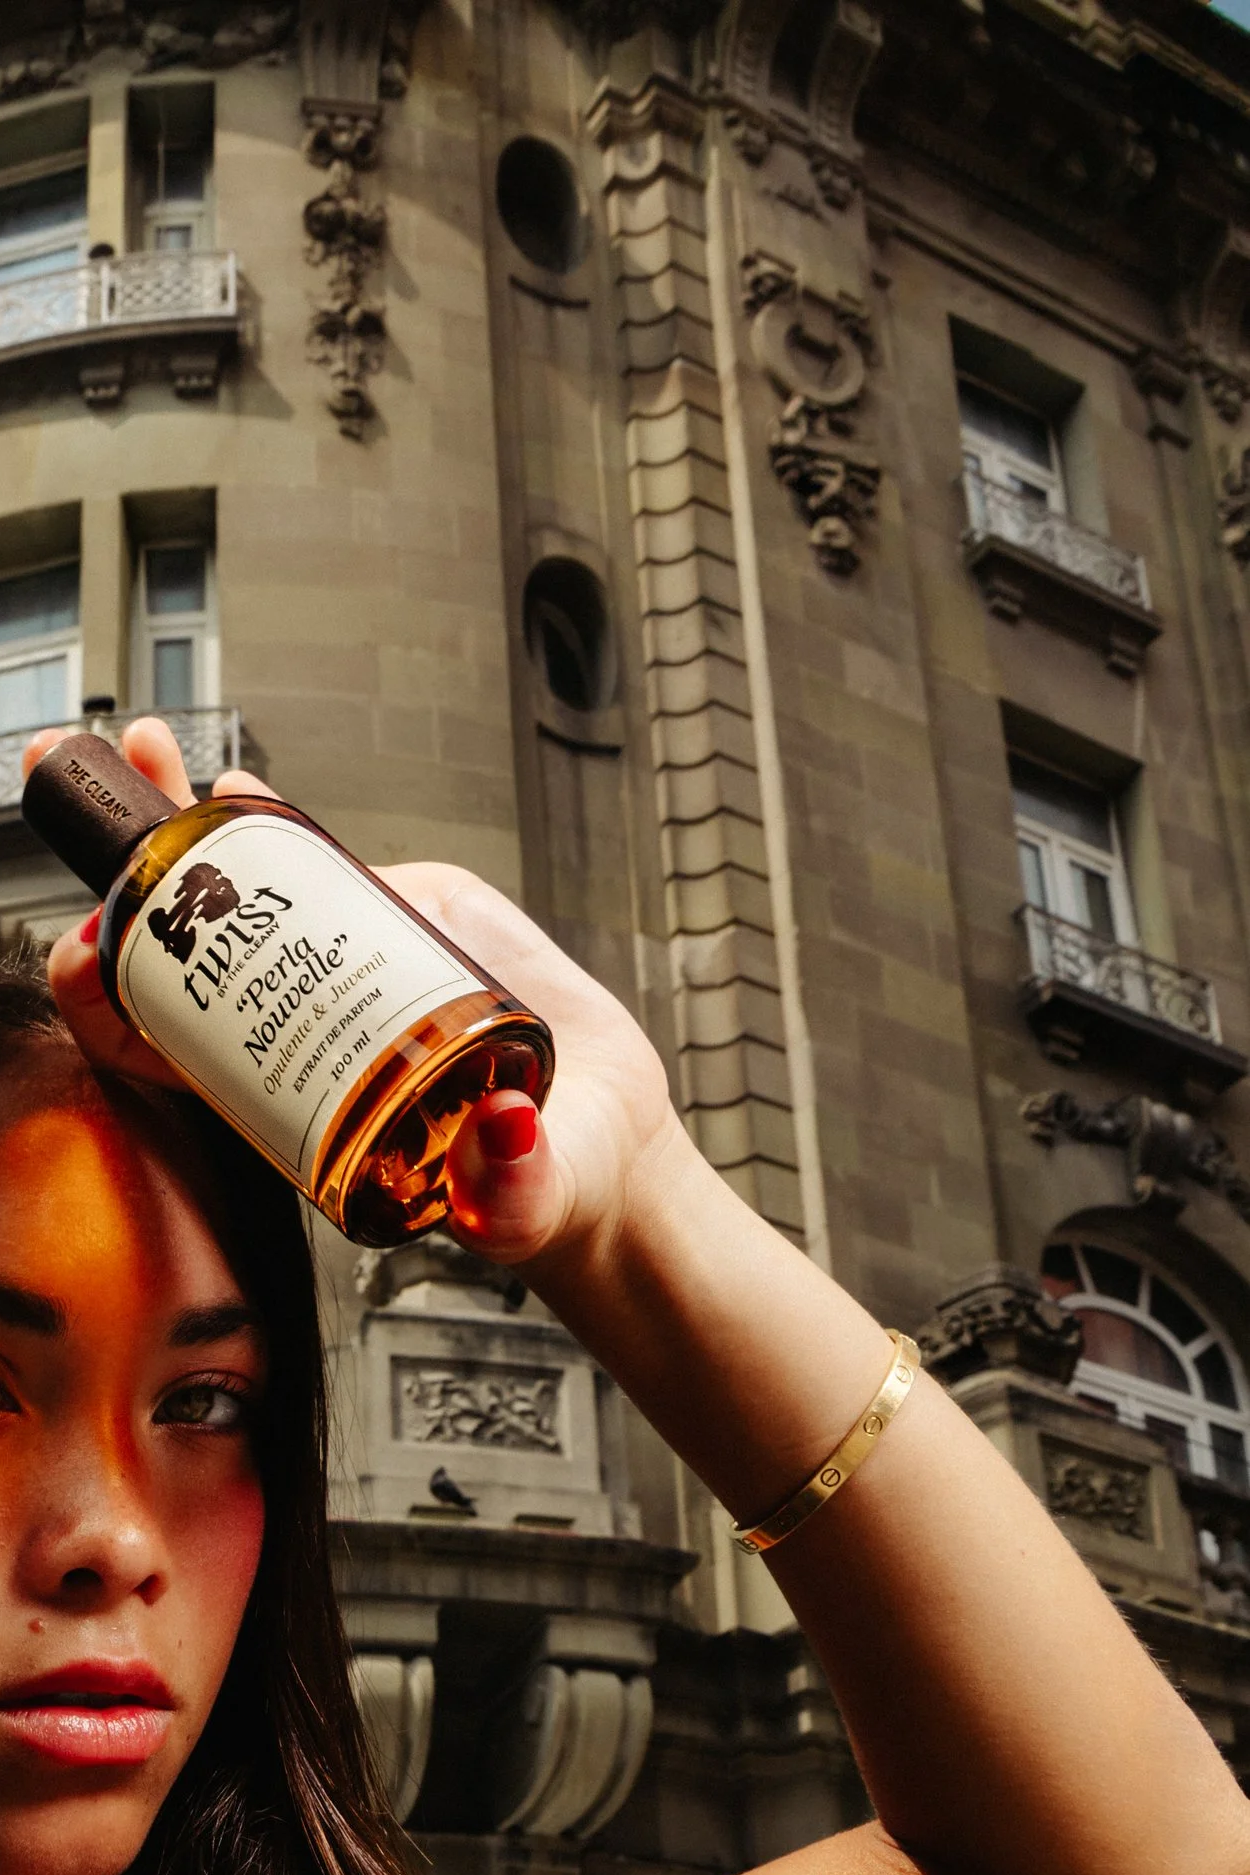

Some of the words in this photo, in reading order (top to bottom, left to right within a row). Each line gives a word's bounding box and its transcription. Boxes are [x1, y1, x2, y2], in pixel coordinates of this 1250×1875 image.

[62, 759, 91, 785] THE
[84, 780, 132, 822] CLEANY
[216, 981, 229, 998] BY
[226, 959, 246, 982] THE
[243, 921, 281, 960] CLEANY
[263, 1019, 313, 1096] Opulente
[311, 1002, 328, 1021] &
[330, 951, 388, 1004] Juvenil
[292, 1041, 328, 1094] EXTRAIT
[325, 1025, 342, 1045] DE
[338, 987, 383, 1030] PARFUM
[330, 1052, 353, 1081] 100
[352, 1030, 372, 1054] ml
